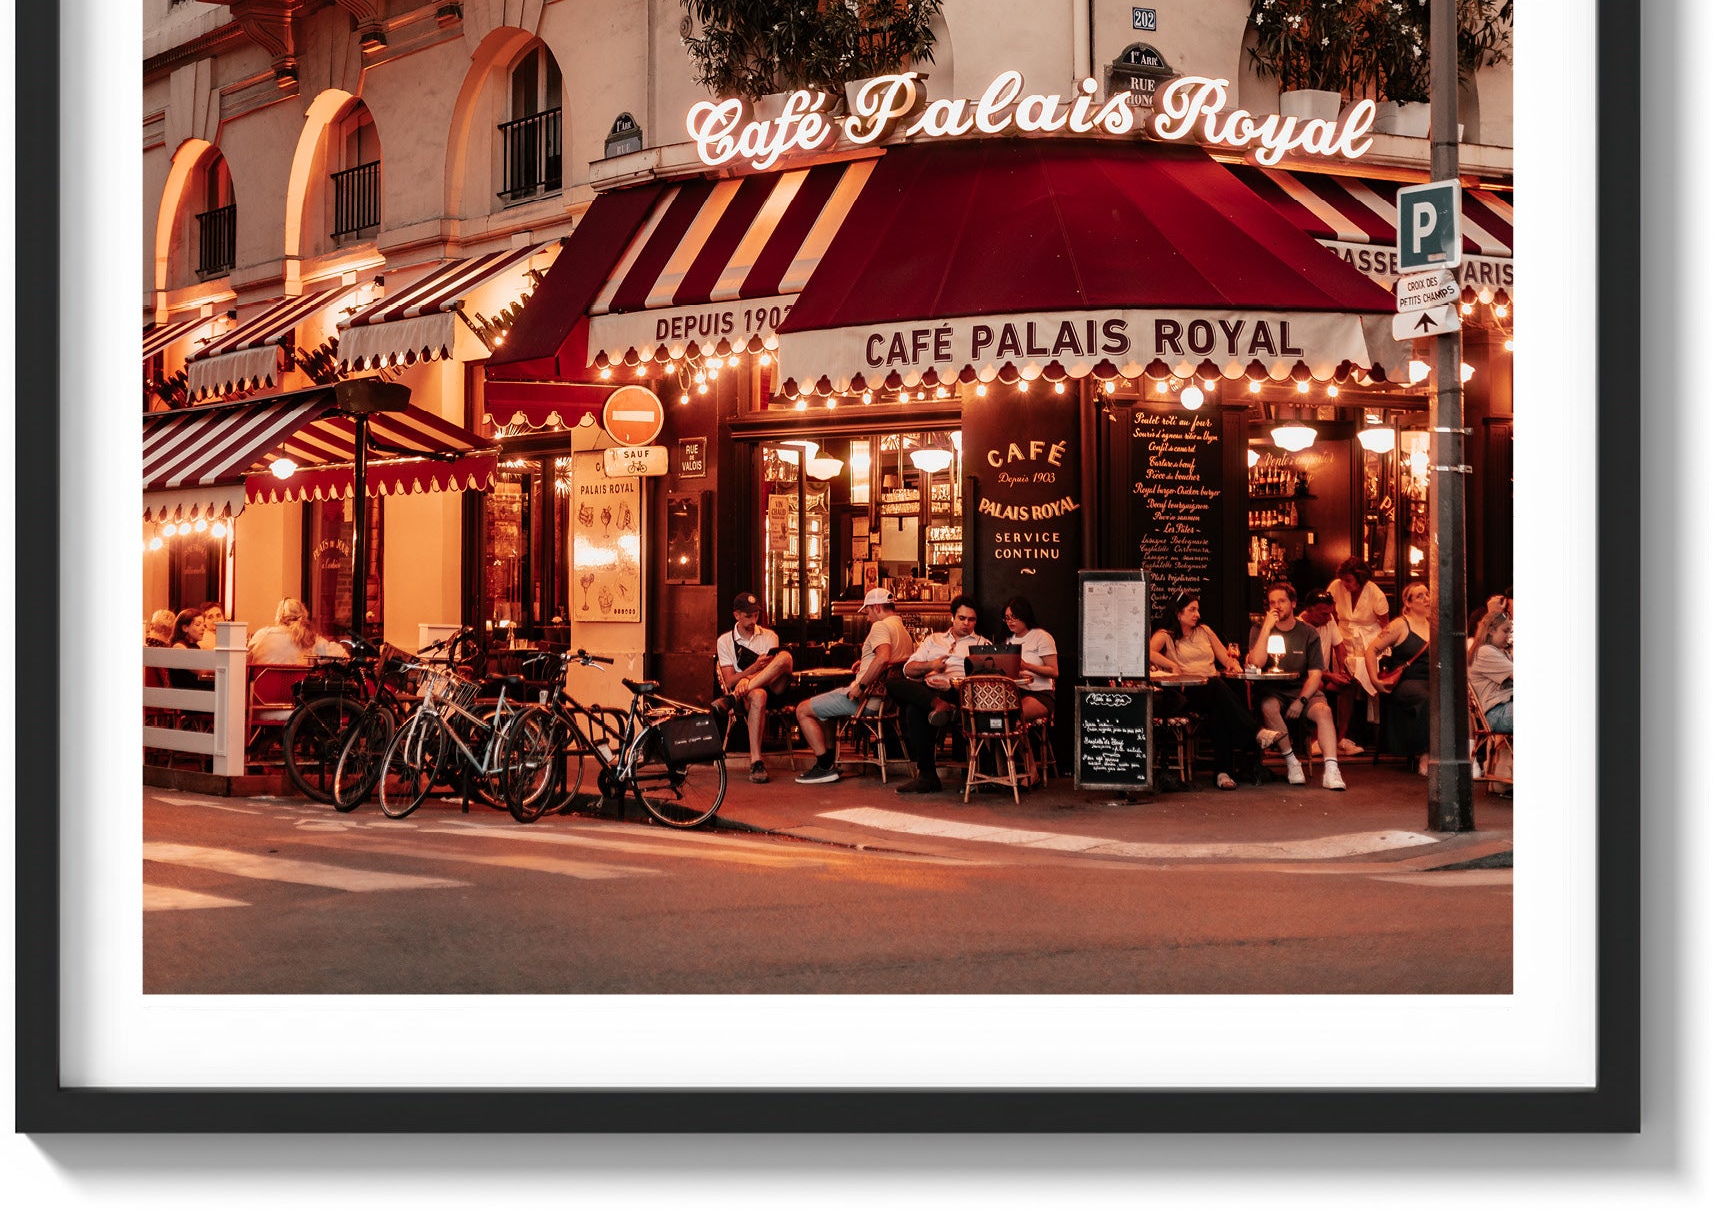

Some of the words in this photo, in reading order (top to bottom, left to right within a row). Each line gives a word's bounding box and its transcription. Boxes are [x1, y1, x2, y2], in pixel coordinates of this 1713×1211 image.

[1135, 10, 1154, 28] 202
[1130, 76, 1156, 92] RUE
[686, 90, 832, 171] Café
[844, 70, 1136, 144] Palais
[1155, 76, 1377, 167] Royal
[1412, 201, 1437, 255] P
[1407, 280, 1425, 292] CROIX
[1426, 277, 1438, 287] DES
[1400, 293, 1422, 307] PETITS
[1422, 285, 1455, 303] CHAMPS
[656, 311, 734, 341] DEPUIS
[866, 322, 953, 368] CAFÉ
[971, 318, 1131, 361] PALAIS
[1154, 318, 1304, 357] ROYAL
[1134, 412, 1160, 425] Poulet
[1190, 415, 1213, 432] four
[1133, 427, 1155, 438] Souris
[623, 450, 650, 459] SAUF
[685, 444, 699, 455] RUE
[987, 440, 1067, 468] CAFÉ
[1148, 441, 1168, 457] Confit
[682, 460, 702, 471] VALOIS
[998, 472, 1029, 488] Depuis
[1033, 472, 1056, 483] 1903
[580, 484, 607, 495] PALAIS
[609, 482, 634, 494] ROYAL
[1133, 482, 1157, 498] Royal
[1200, 485, 1221, 499] burger
[978, 497, 1029, 522] PALAIS
[1031, 495, 1080, 521] ROYAL
[1163, 522, 1175, 534] Les
[994, 532, 1061, 543] SERVICE
[994, 548, 1060, 559] CONTINU
